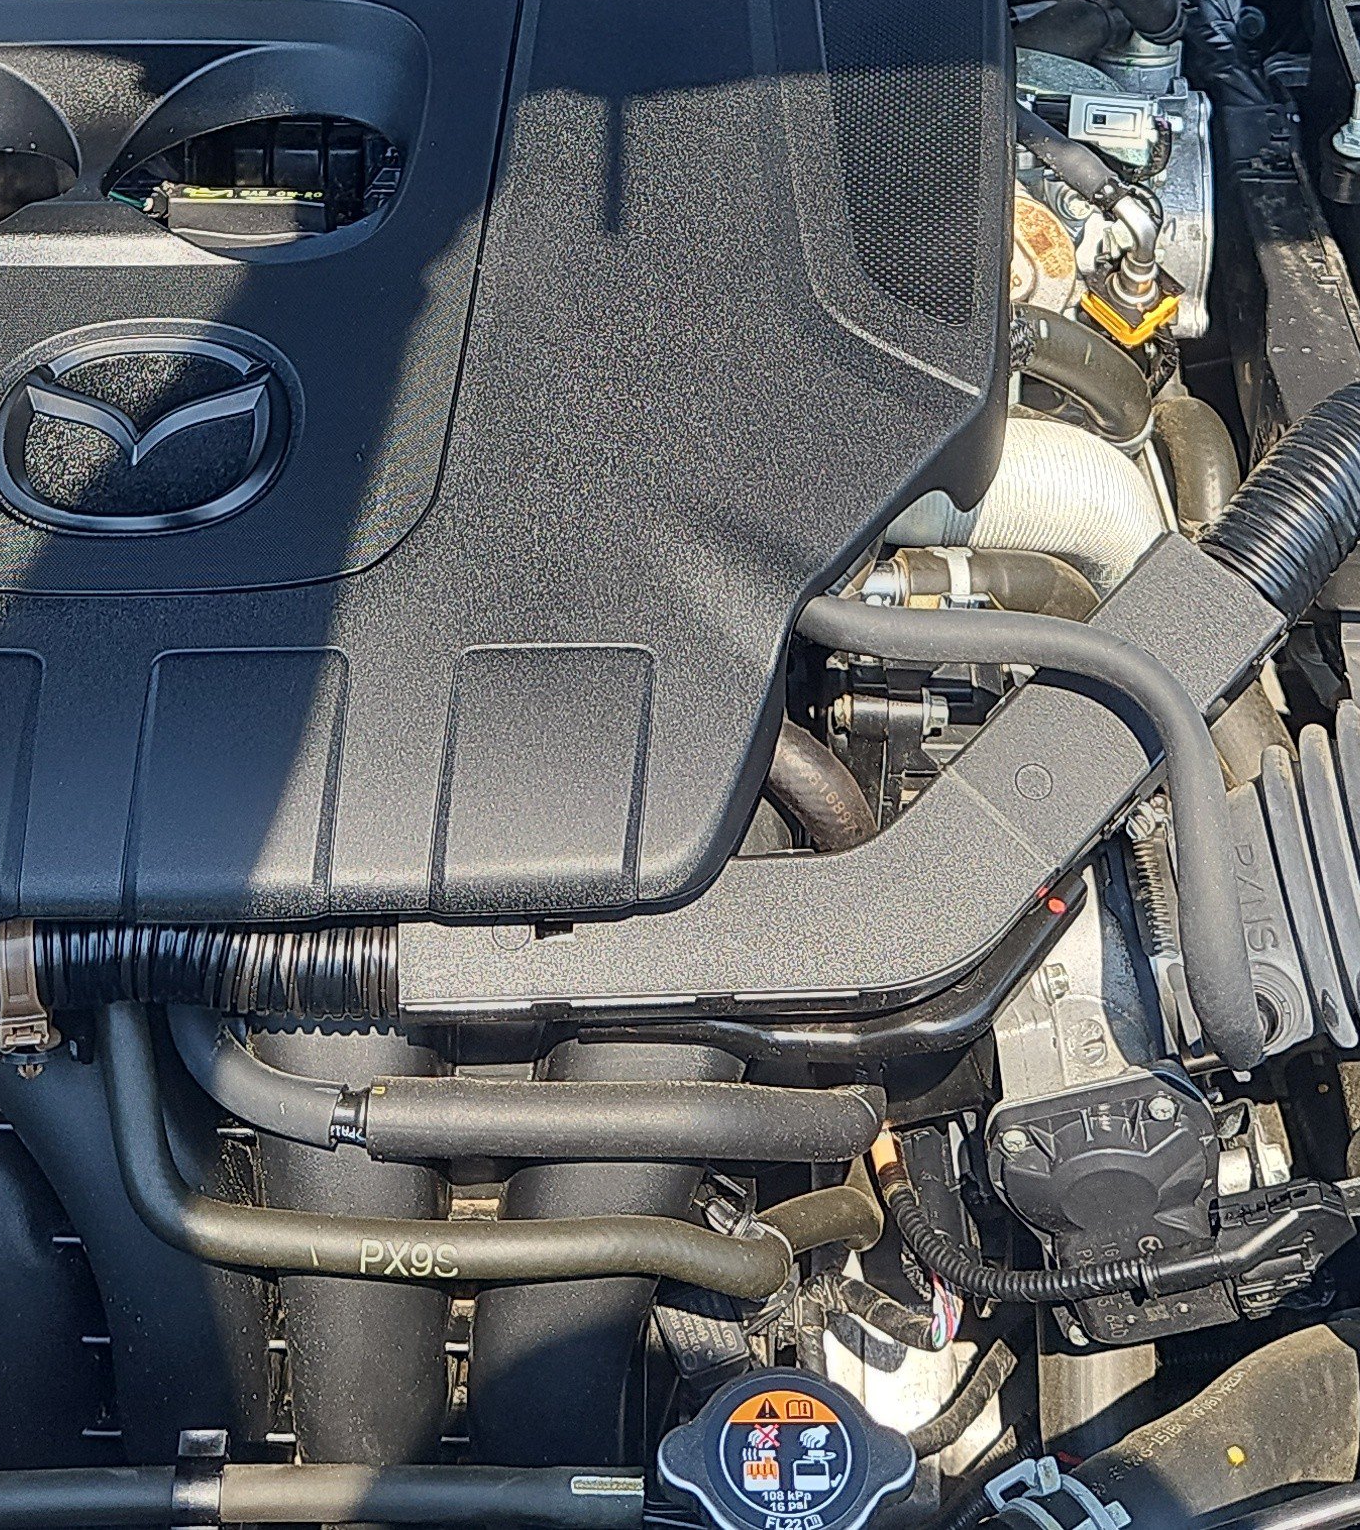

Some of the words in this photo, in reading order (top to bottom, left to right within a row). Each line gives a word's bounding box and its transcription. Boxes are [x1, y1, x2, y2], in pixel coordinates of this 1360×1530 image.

[358, 1238, 460, 1278] PX9S
[762, 1490, 785, 1501] 108
[788, 1490, 812, 1501] kPa
[769, 1501, 786, 1512] 16
[788, 1501, 808, 1512] psi
[765, 1515, 802, 1530] FL22
